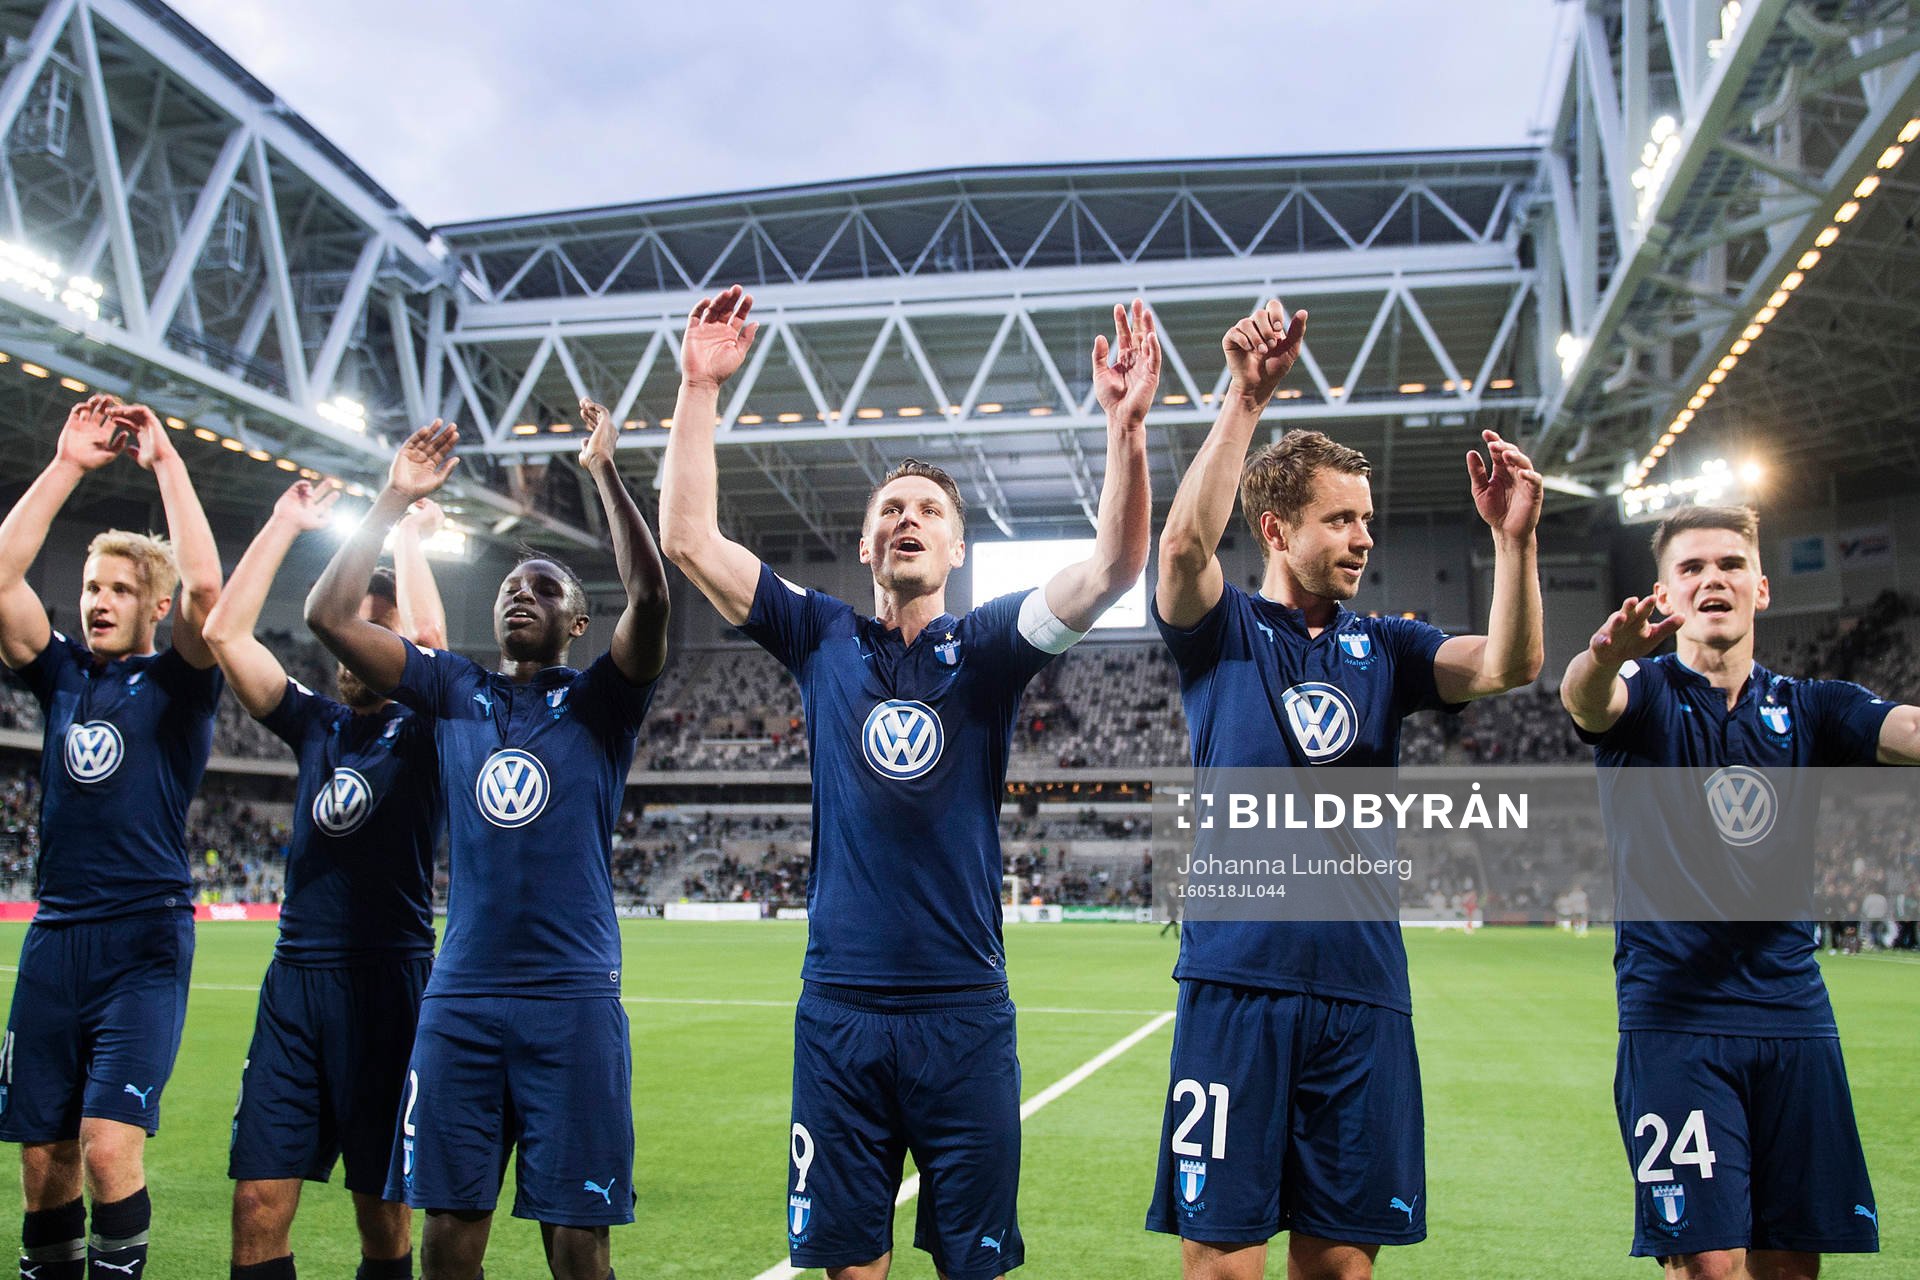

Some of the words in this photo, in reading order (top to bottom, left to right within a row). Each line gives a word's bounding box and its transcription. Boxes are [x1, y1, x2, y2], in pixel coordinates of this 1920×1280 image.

[869, 706, 937, 772] VW
[482, 756, 542, 820] VW
[1707, 773, 1771, 839] VW
[1172, 1079, 1229, 1159] 21
[1635, 1110, 1716, 1183] 24
[792, 1123, 814, 1192] 9
